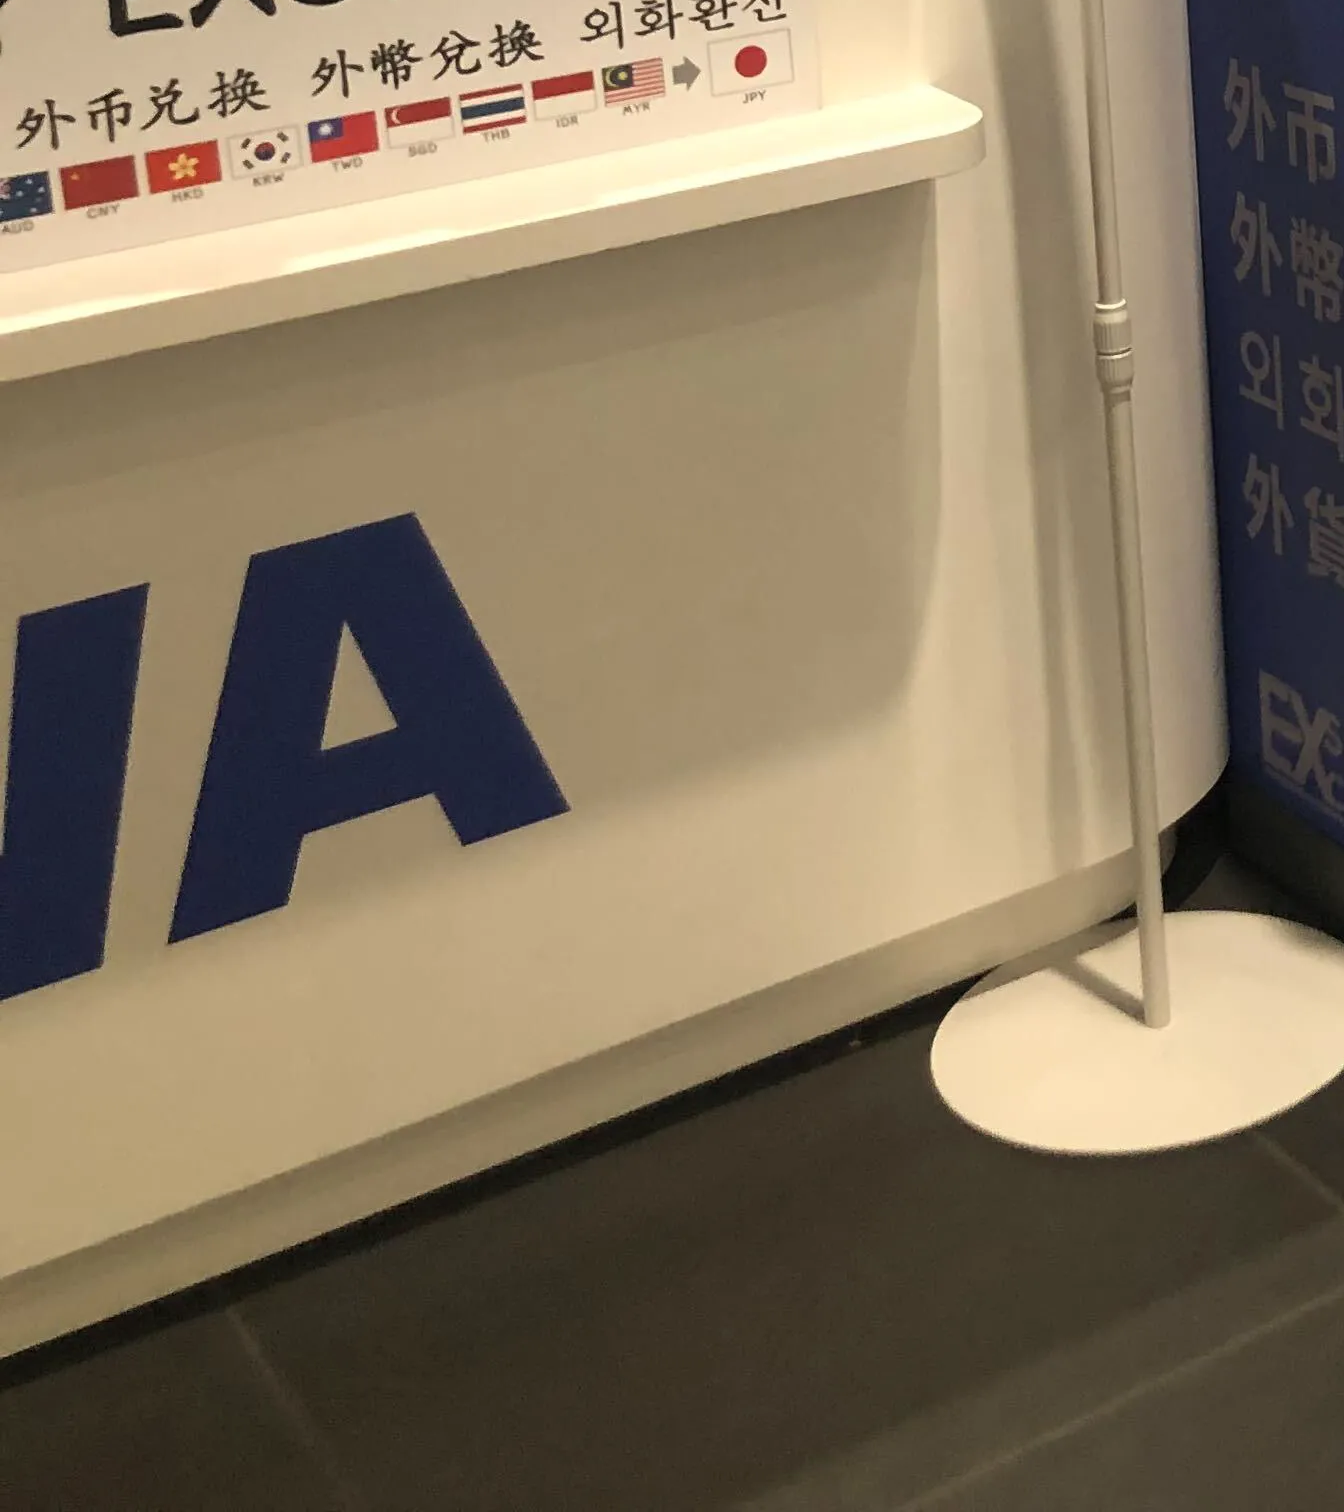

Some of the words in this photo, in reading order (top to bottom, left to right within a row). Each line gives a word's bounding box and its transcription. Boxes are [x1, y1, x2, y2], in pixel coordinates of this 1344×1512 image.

[741, 88, 767, 104] JPY
[16, 68, 271, 151] 外币兑换
[622, 100, 652, 116] MYR
[554, 114, 579, 128] IDR
[481, 126, 511, 143] THB
[407, 141, 438, 158] SGD
[331, 155, 364, 172] TWD
[252, 171, 286, 188] KRW
[172, 187, 205, 204] HKD
[86, 202, 120, 220] CNY
